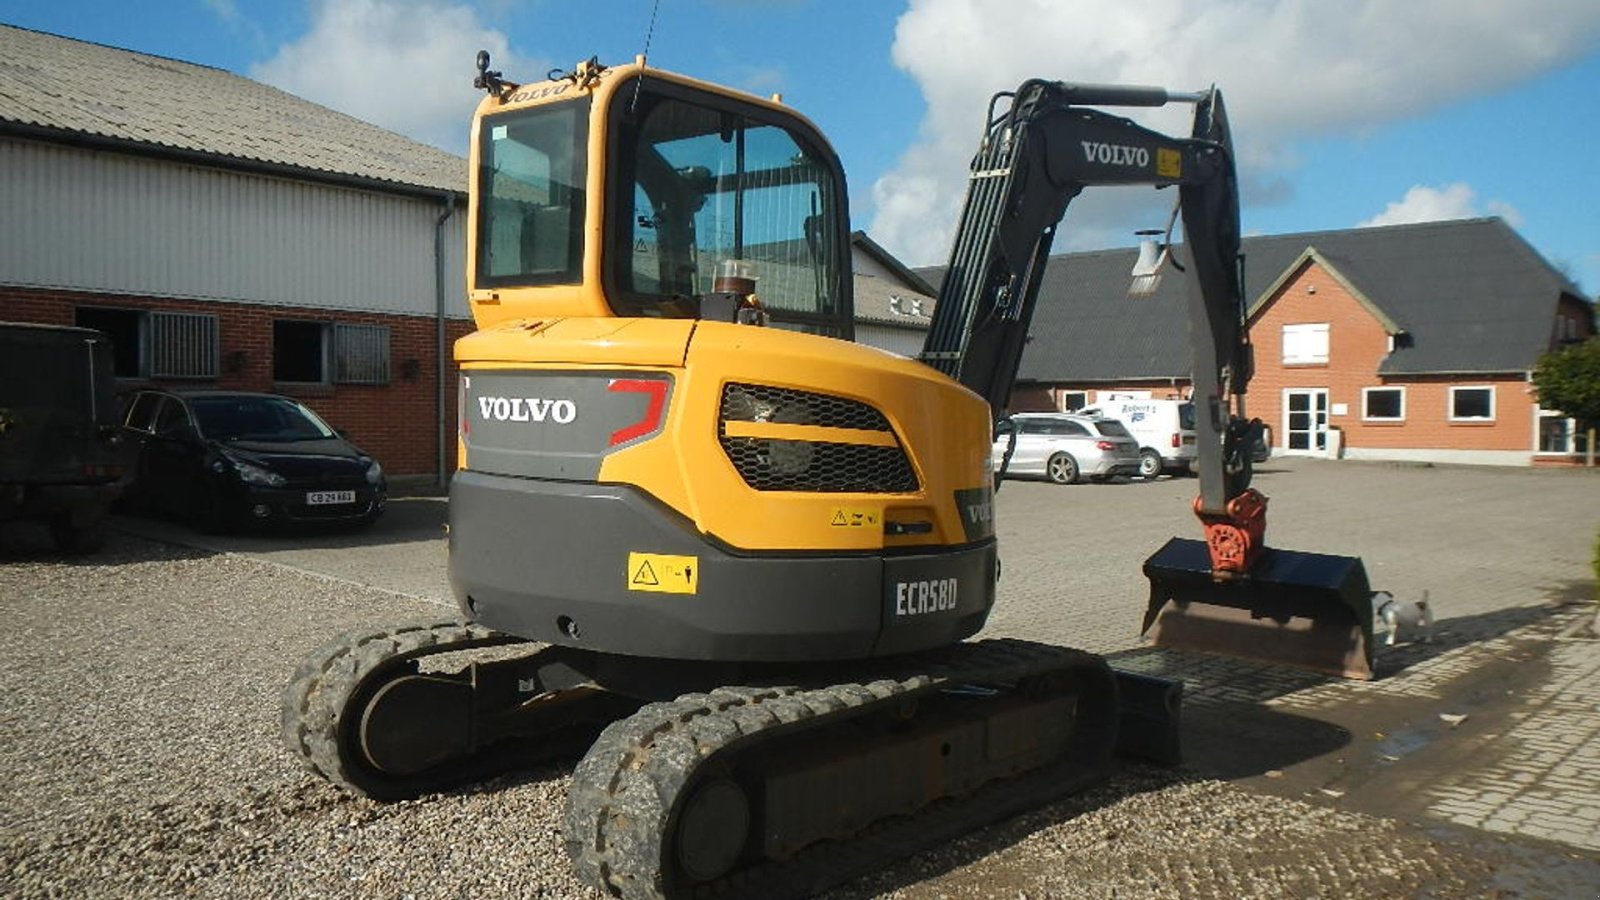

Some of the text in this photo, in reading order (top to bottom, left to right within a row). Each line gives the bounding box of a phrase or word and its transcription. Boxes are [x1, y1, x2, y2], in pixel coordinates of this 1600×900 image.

[1081, 140, 1149, 167] VOLVO
[478, 396, 576, 423] VOLVO
[896, 578, 957, 615] ECR58D
